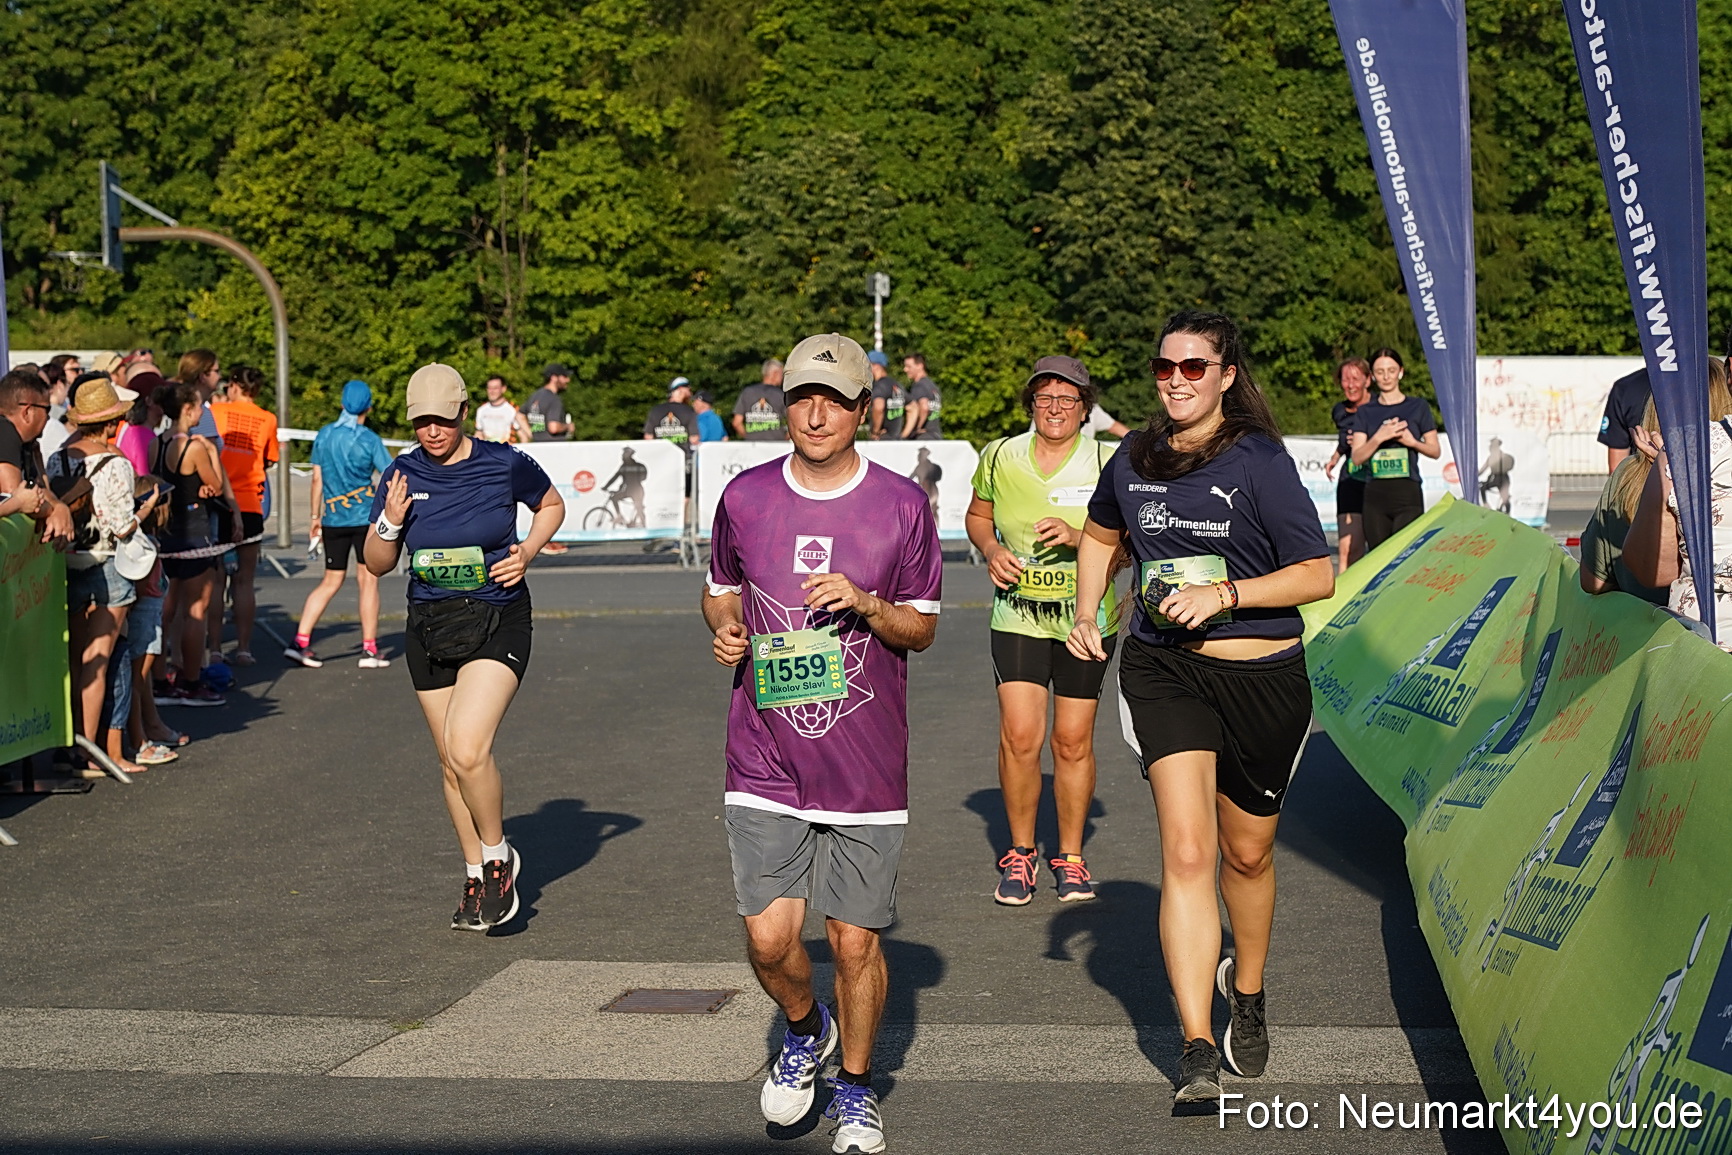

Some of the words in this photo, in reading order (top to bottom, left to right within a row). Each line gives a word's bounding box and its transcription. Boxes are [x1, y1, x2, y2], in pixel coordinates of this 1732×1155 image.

[812, 356, 838, 364] adidas
[1377, 458, 1403, 470] 1083
[1168, 516, 1231, 531] Firmenlauf
[1191, 530, 1230, 538] neumarkt
[797, 550, 829, 559] FUCHS
[426, 564, 475, 580] 1273
[1022, 569, 1066, 586] 1509
[765, 653, 827, 684] 1559
[828, 654, 842, 689] 2022
[757, 668, 767, 694] RUN
[770, 684, 801, 694] Nikolov
[802, 679, 826, 690] Slavi
